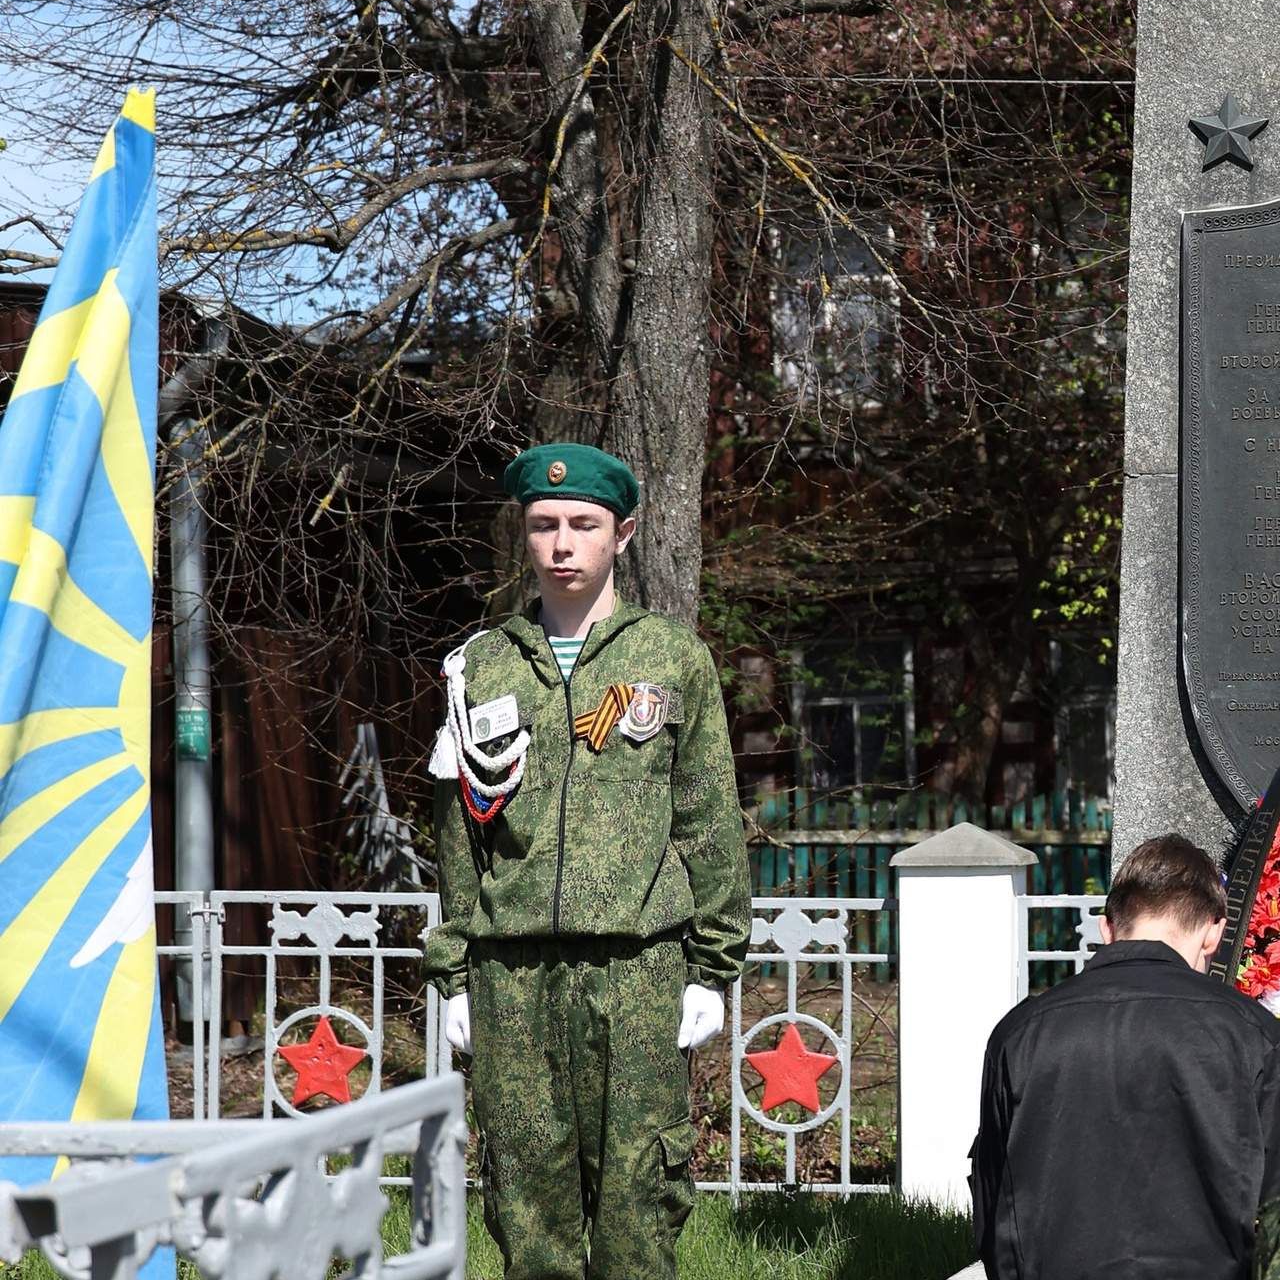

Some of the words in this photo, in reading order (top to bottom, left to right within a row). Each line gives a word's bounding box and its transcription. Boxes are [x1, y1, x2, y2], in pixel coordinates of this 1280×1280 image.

[1244, 439, 1255, 452] С
[1219, 588, 1280, 605] ВТОРОЙ
[1252, 640, 1273, 654] НА
